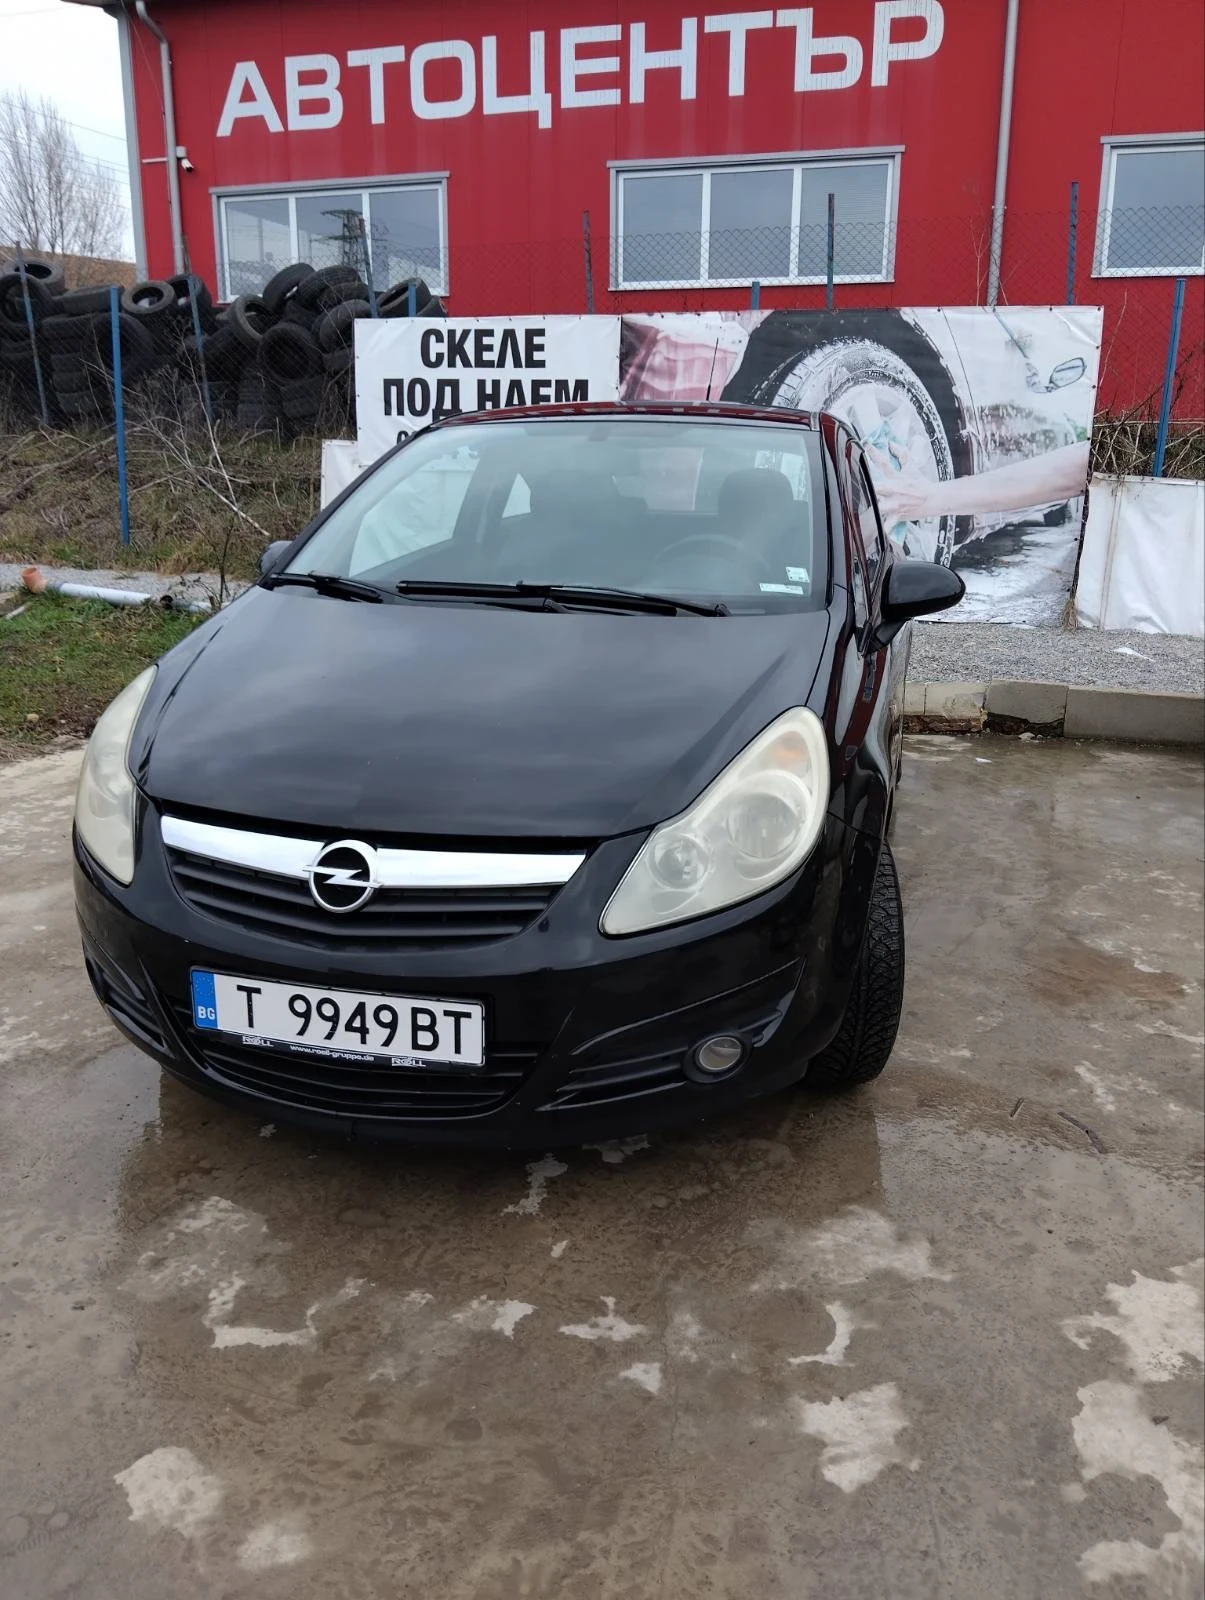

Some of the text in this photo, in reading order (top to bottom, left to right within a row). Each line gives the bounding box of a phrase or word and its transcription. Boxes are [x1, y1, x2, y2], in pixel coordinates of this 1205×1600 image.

[216, 0, 945, 137] АВТОЦЕНТЪР
[420, 328, 546, 368] СКЕЛЕ
[383, 377, 463, 422] ПОД
[197, 1005, 216, 1020] BG
[236, 984, 262, 1028] T
